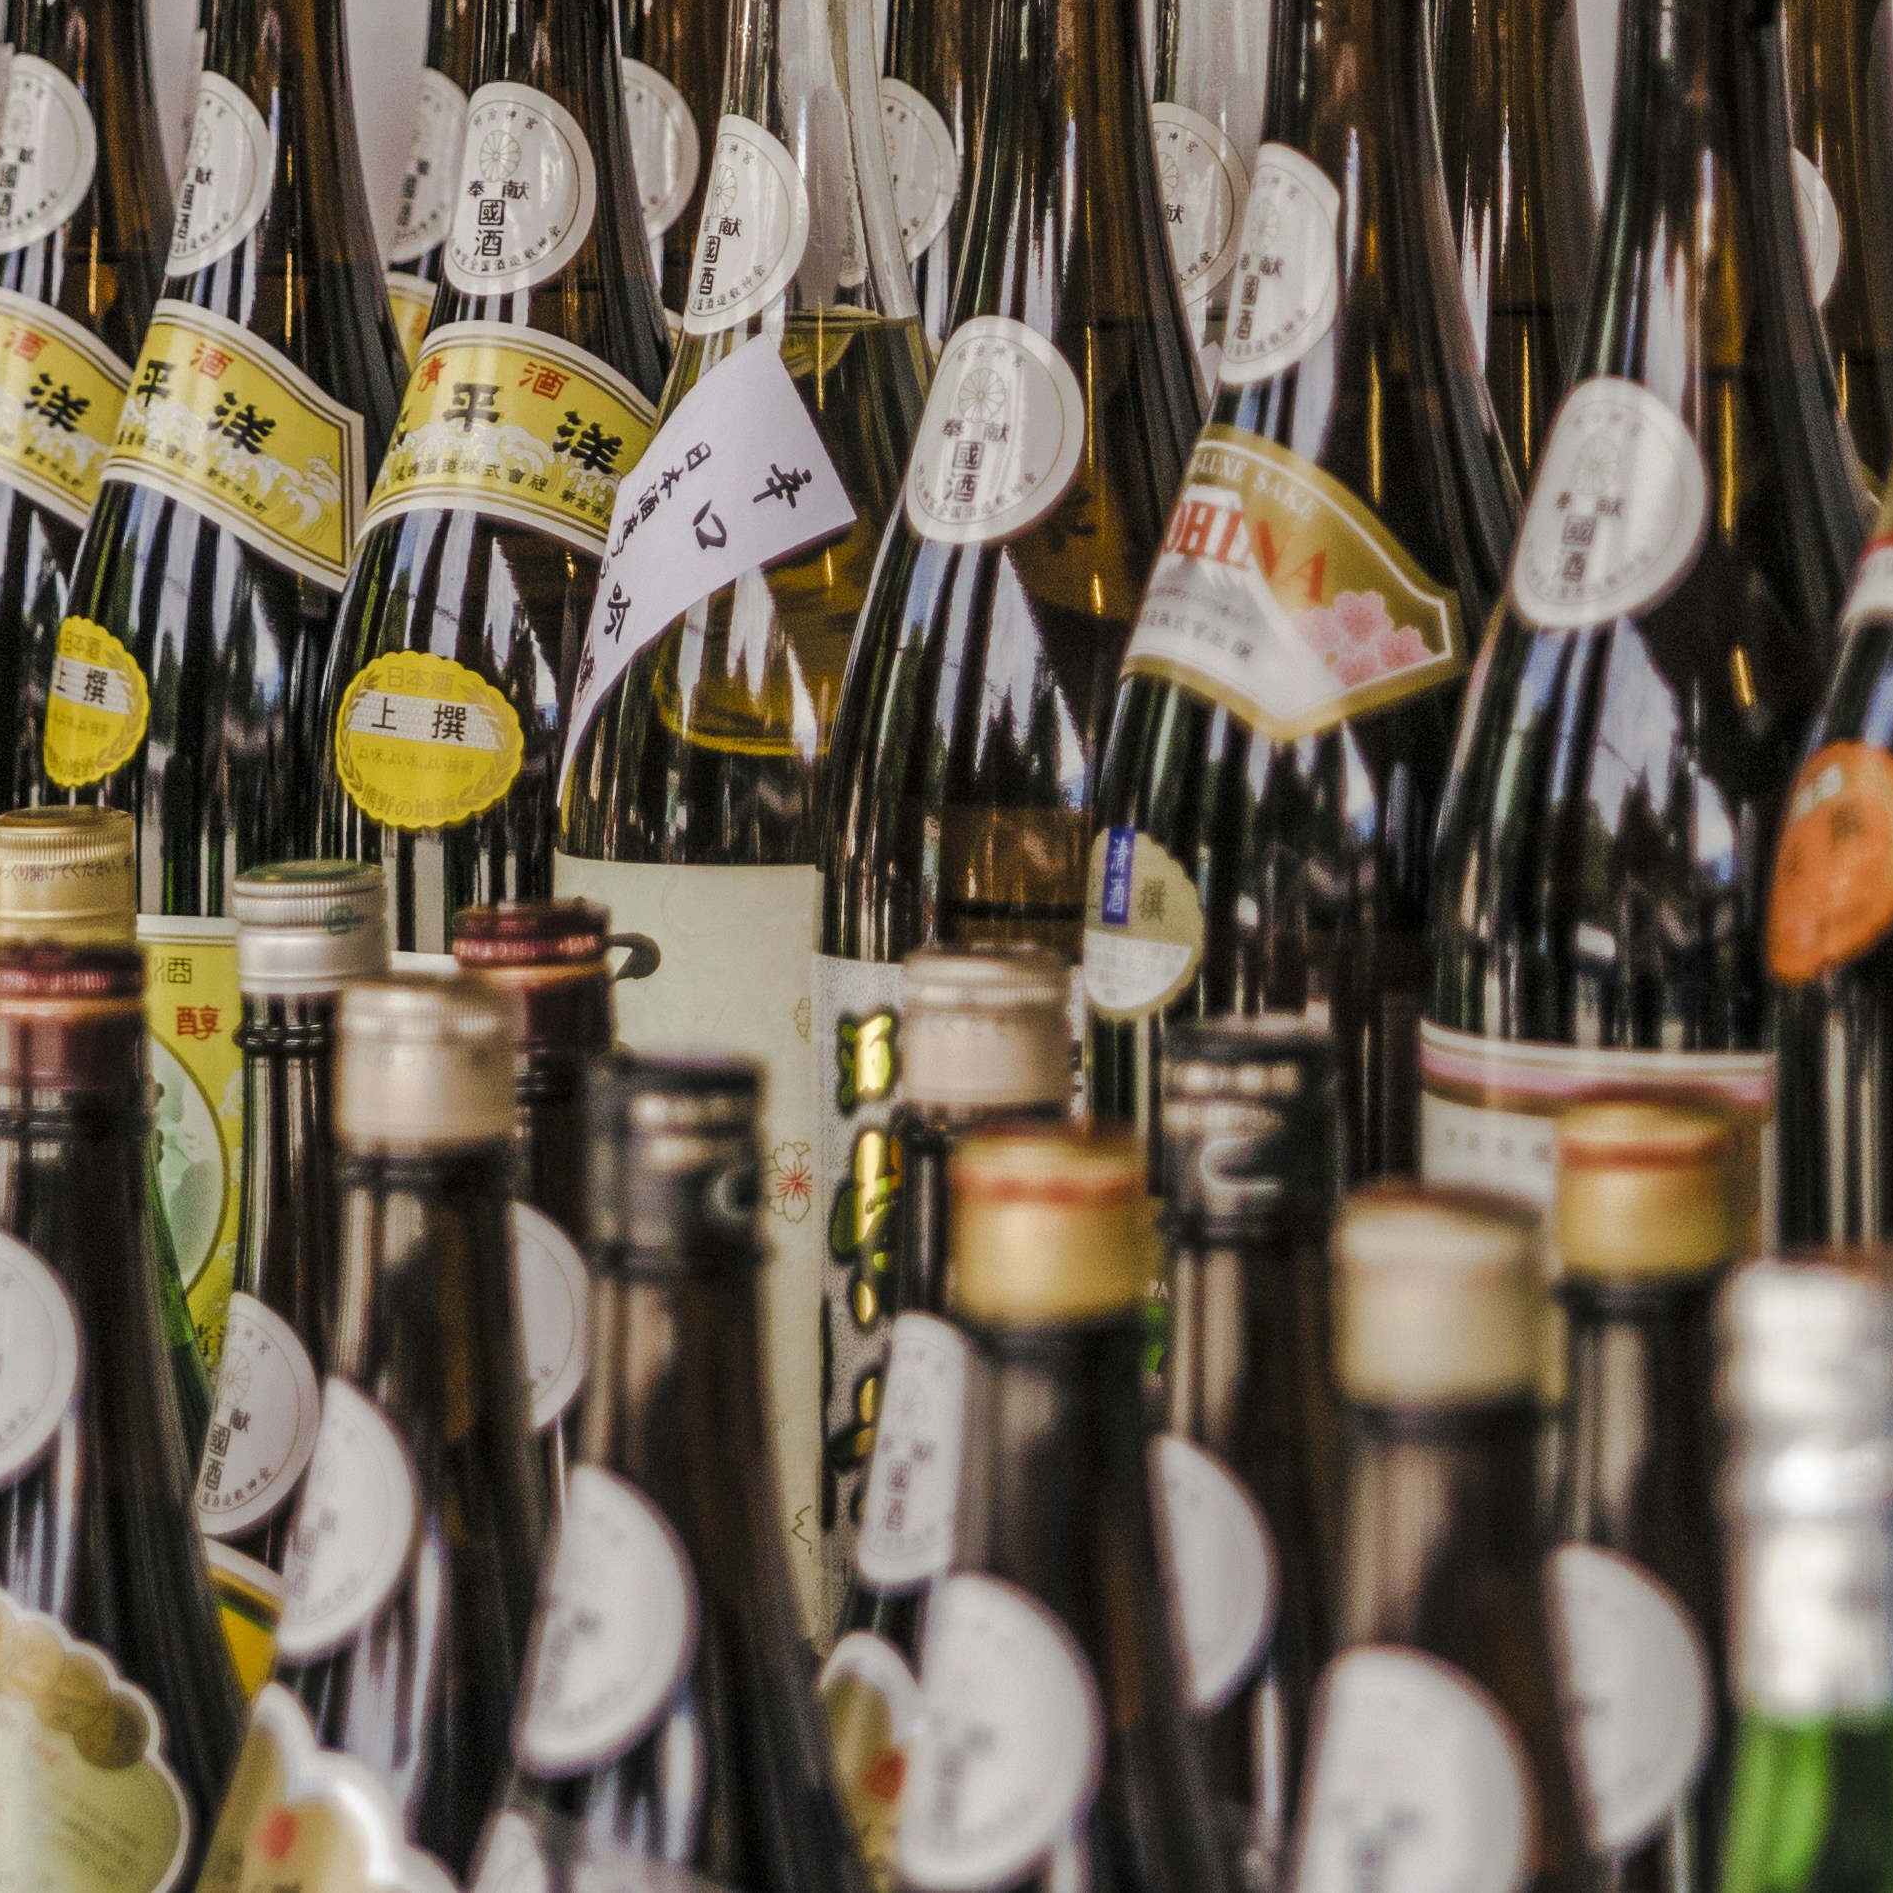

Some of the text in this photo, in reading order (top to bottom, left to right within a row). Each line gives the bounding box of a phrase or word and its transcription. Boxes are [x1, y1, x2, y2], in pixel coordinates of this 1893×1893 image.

[467, 179, 532, 200] 奉献
[474, 198, 506, 258] 國酒
[399, 380, 624, 478] 平洋
[944, 440, 986, 503] 國酒
[386, 665, 456, 692] 日本酒
[371, 696, 469, 743] 上撰
[1105, 835, 1131, 915] 清酒
[176, 1005, 222, 1041] 醇
